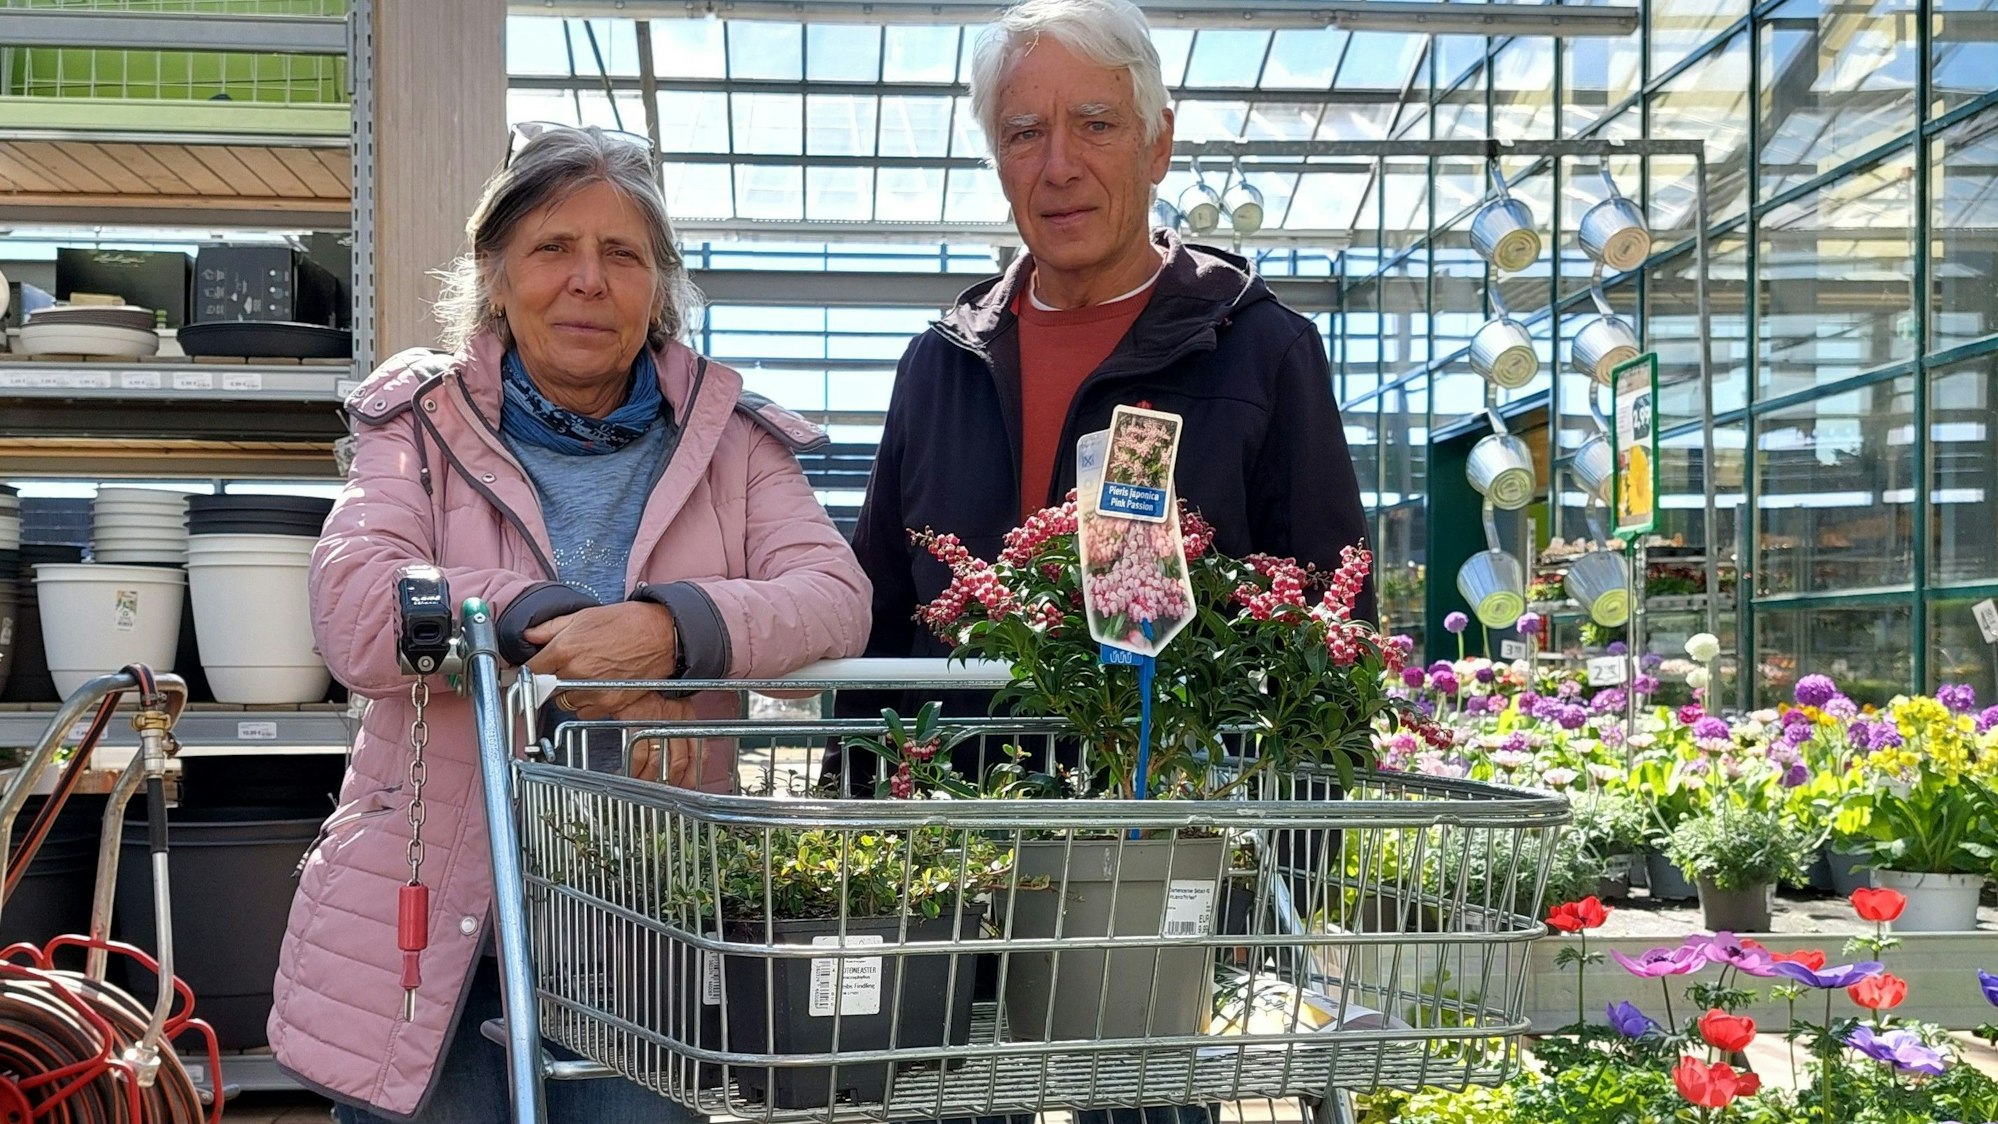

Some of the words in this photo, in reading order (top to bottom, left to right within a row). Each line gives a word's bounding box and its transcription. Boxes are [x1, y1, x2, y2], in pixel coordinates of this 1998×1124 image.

[1109, 485, 1129, 496] Pieris
[1129, 488, 1160, 501] japonica
[1111, 497, 1126, 507] Pink
[1126, 499, 1154, 511] Passion
